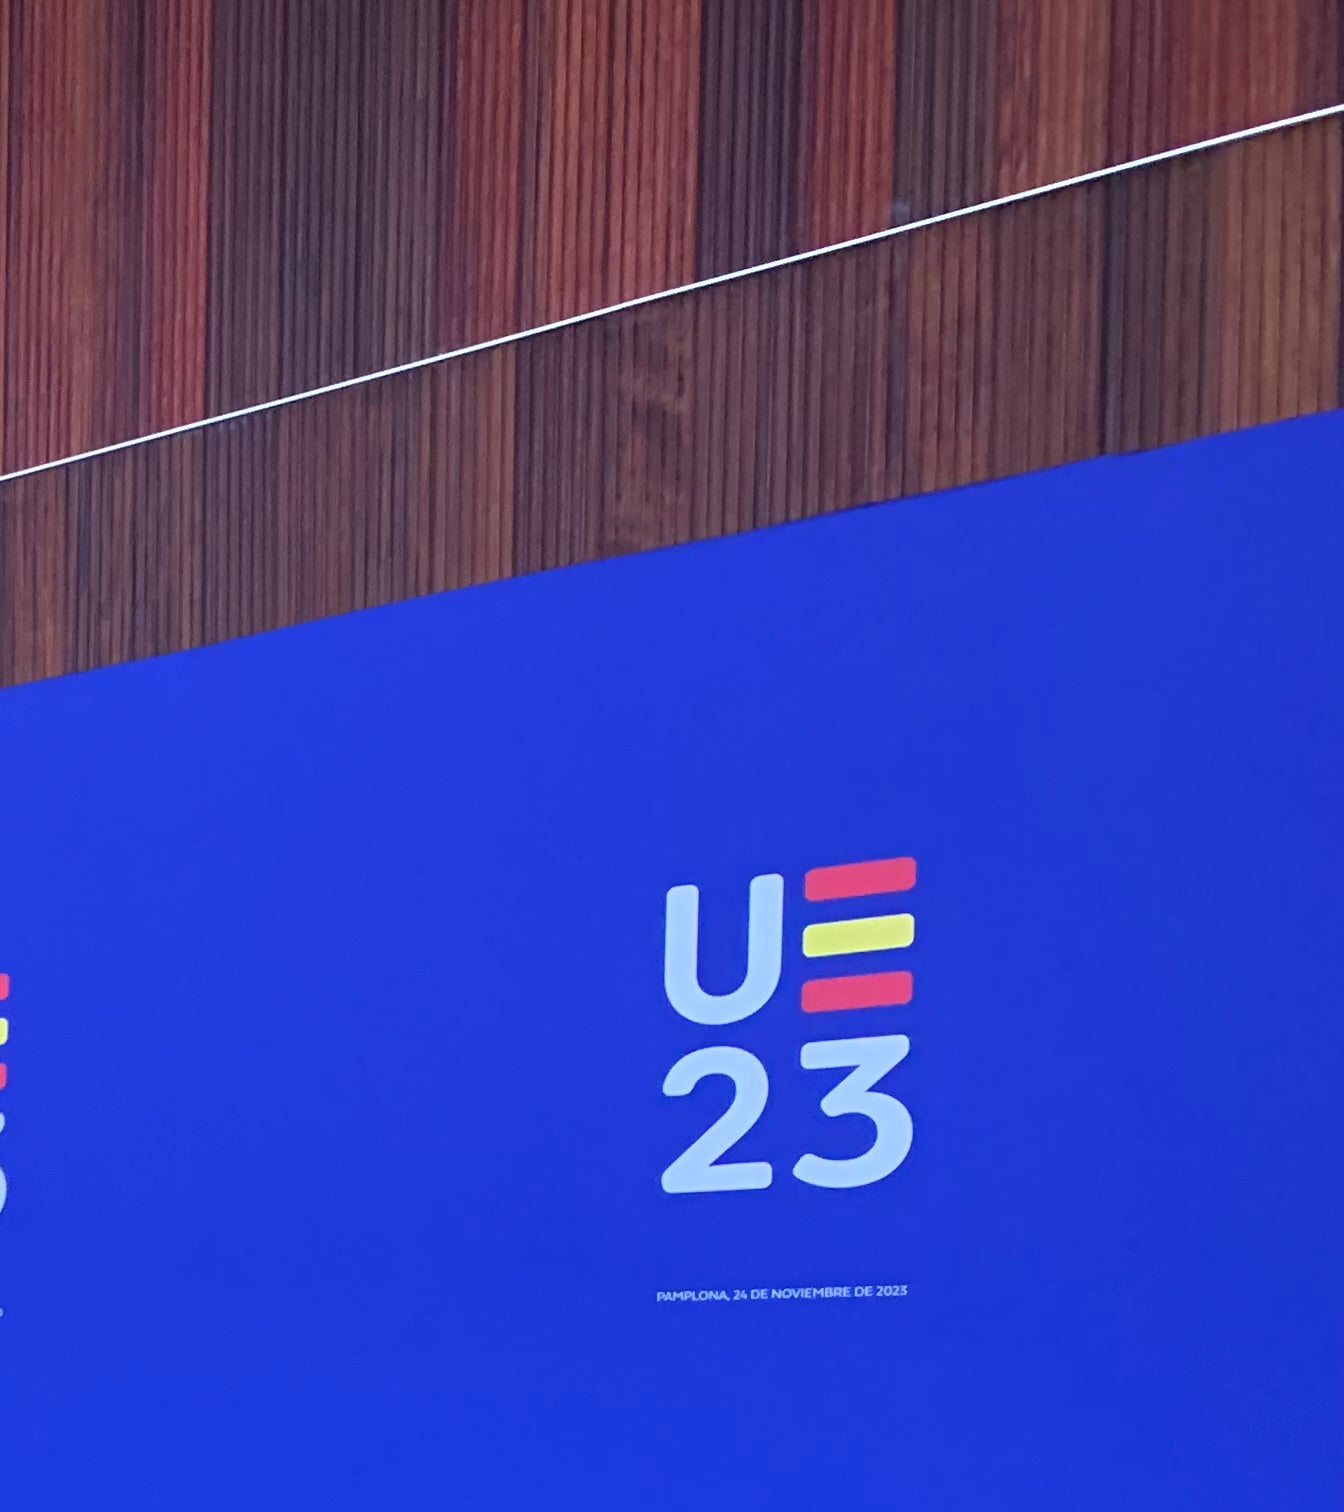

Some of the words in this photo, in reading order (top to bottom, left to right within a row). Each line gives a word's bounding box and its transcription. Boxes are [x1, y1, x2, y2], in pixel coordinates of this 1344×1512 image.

[664, 856, 917, 1025] UE
[661, 1034, 914, 1193] 23
[656, 1290, 731, 1303] PAMPLONA,
[733, 1289, 748, 1301] 24
[750, 1288, 769, 1300] DE
[771, 1286, 852, 1299] NOVIEMBRE
[854, 1285, 874, 1298] DE
[875, 1284, 909, 1297] 2023
